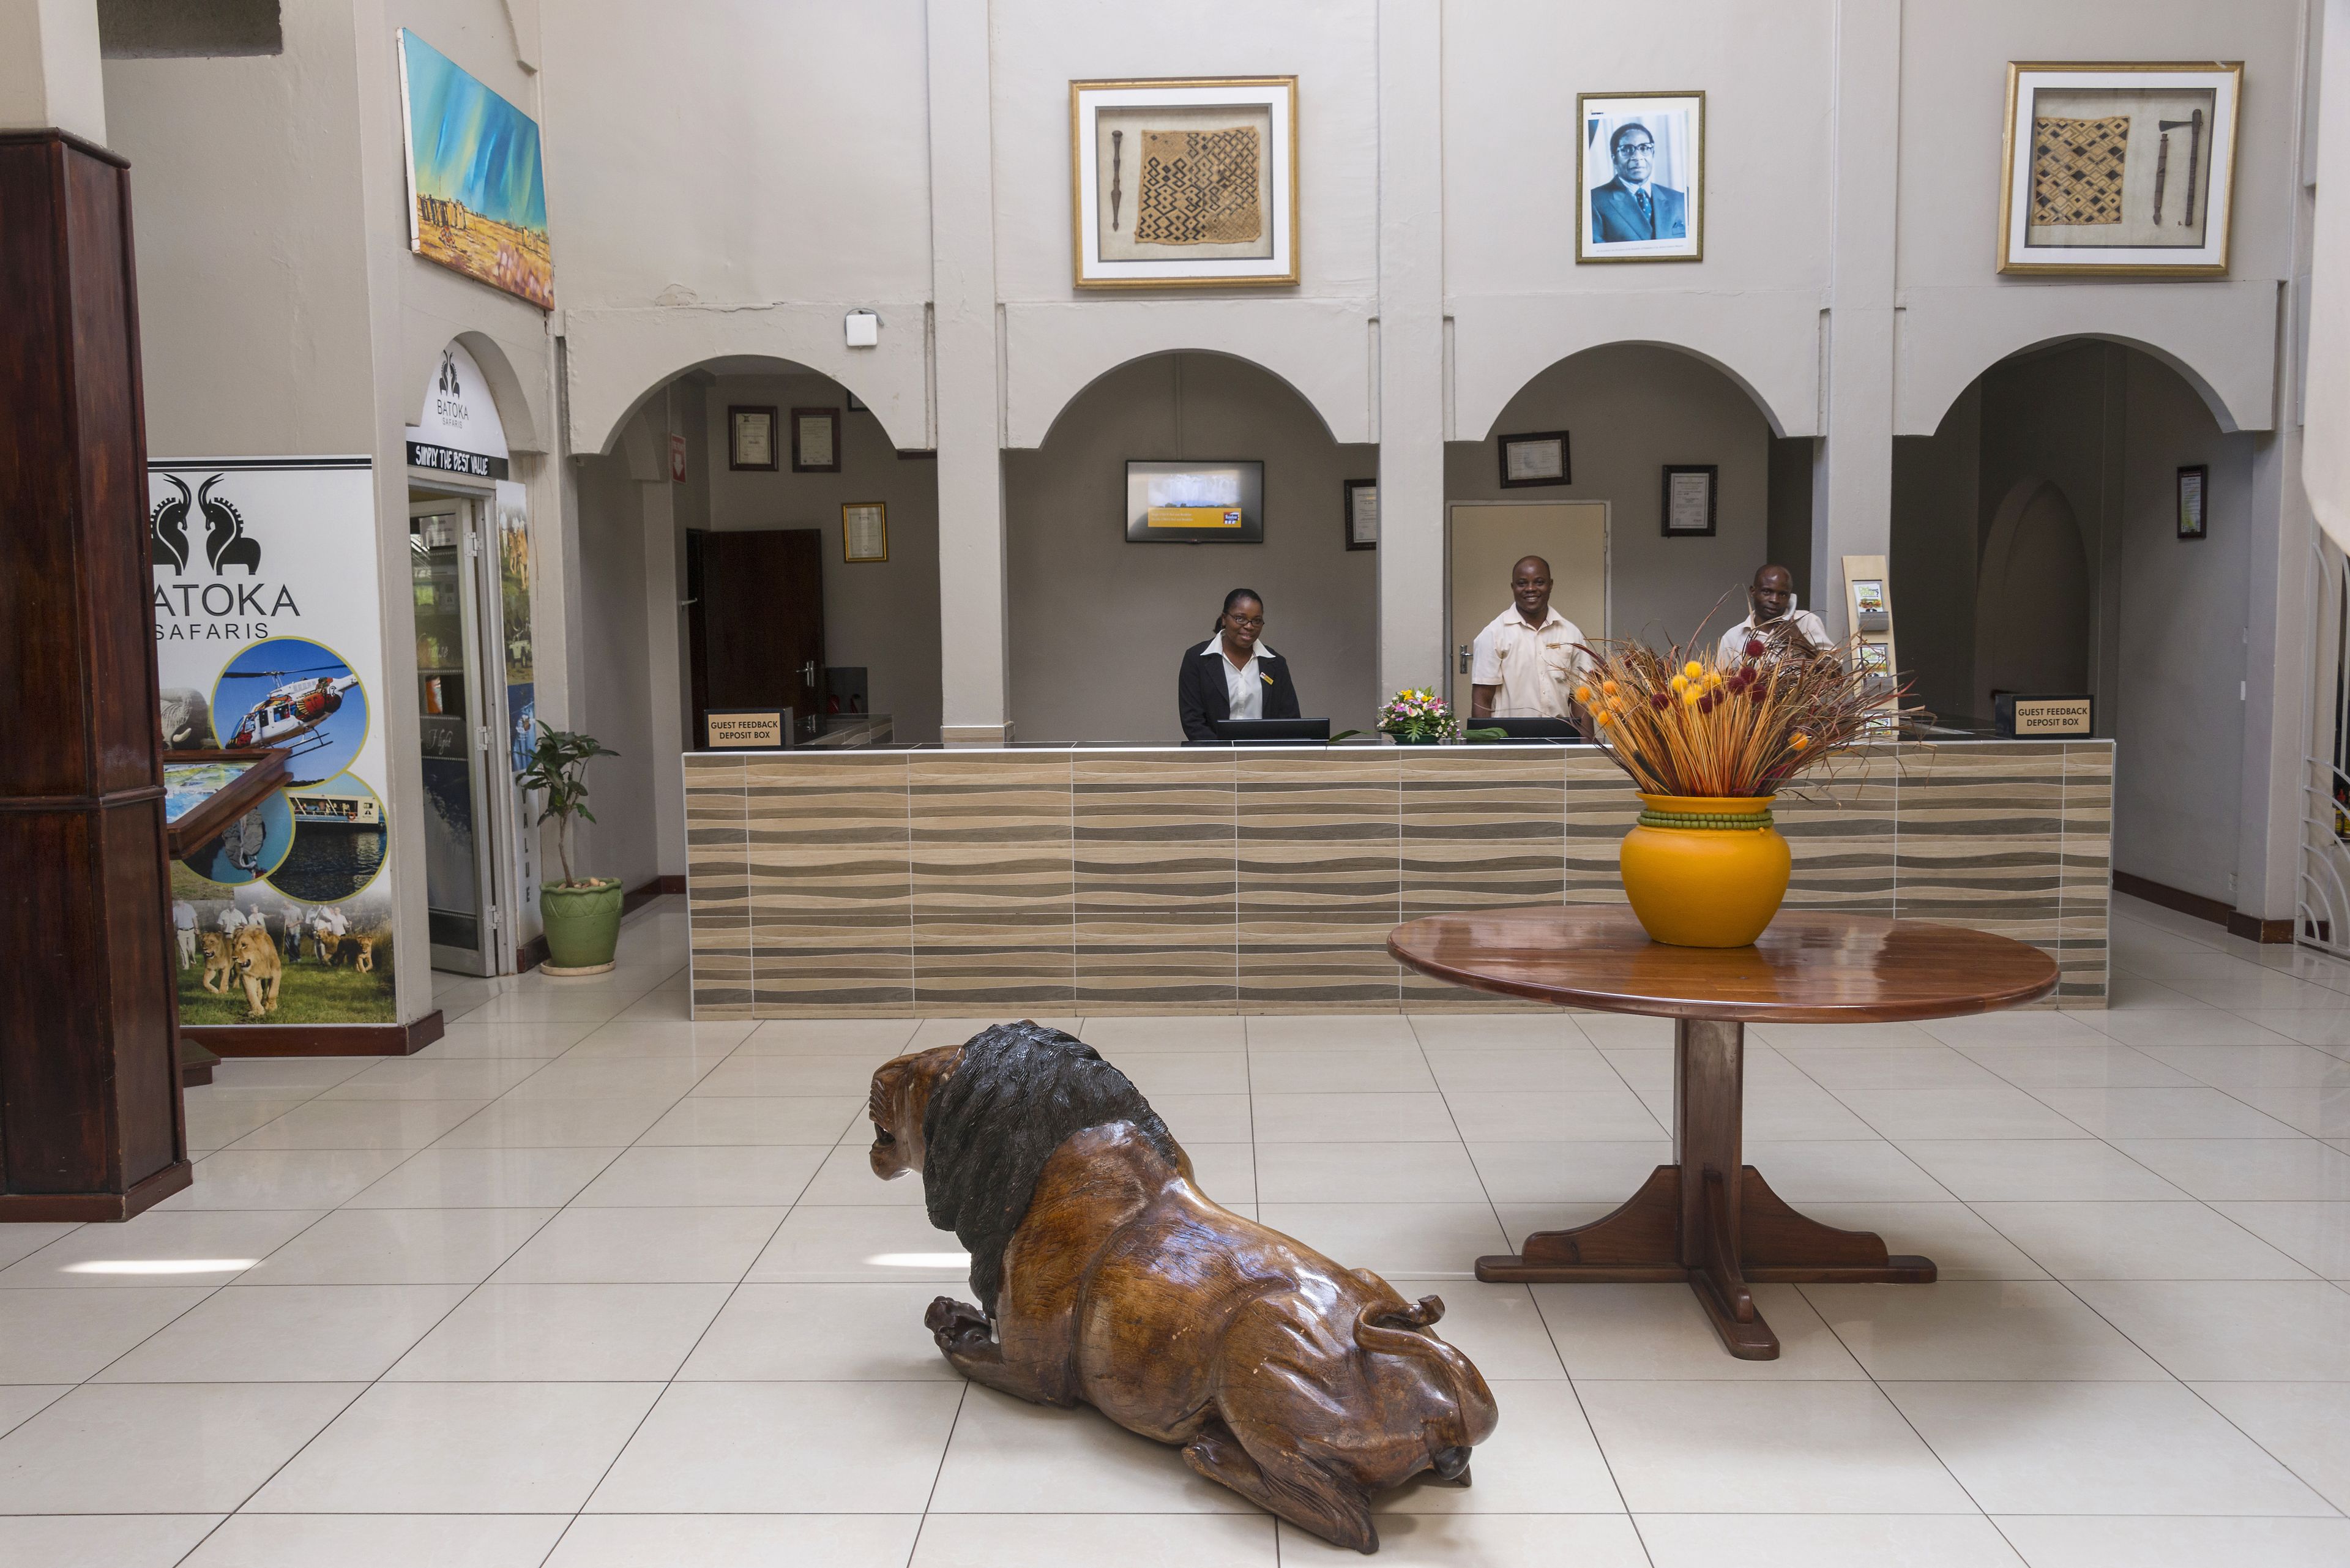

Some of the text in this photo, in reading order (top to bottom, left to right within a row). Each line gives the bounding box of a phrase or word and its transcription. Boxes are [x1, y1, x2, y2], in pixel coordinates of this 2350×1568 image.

[437, 399, 469, 420] BATOKA
[442, 417, 463, 429] SAFARIS
[416, 445, 488, 476] SIMPLY THE BEST VALUE
[154, 583, 300, 616] ATOKA
[155, 622, 269, 640] SAFARIS
[427, 728, 453, 755] Flight
